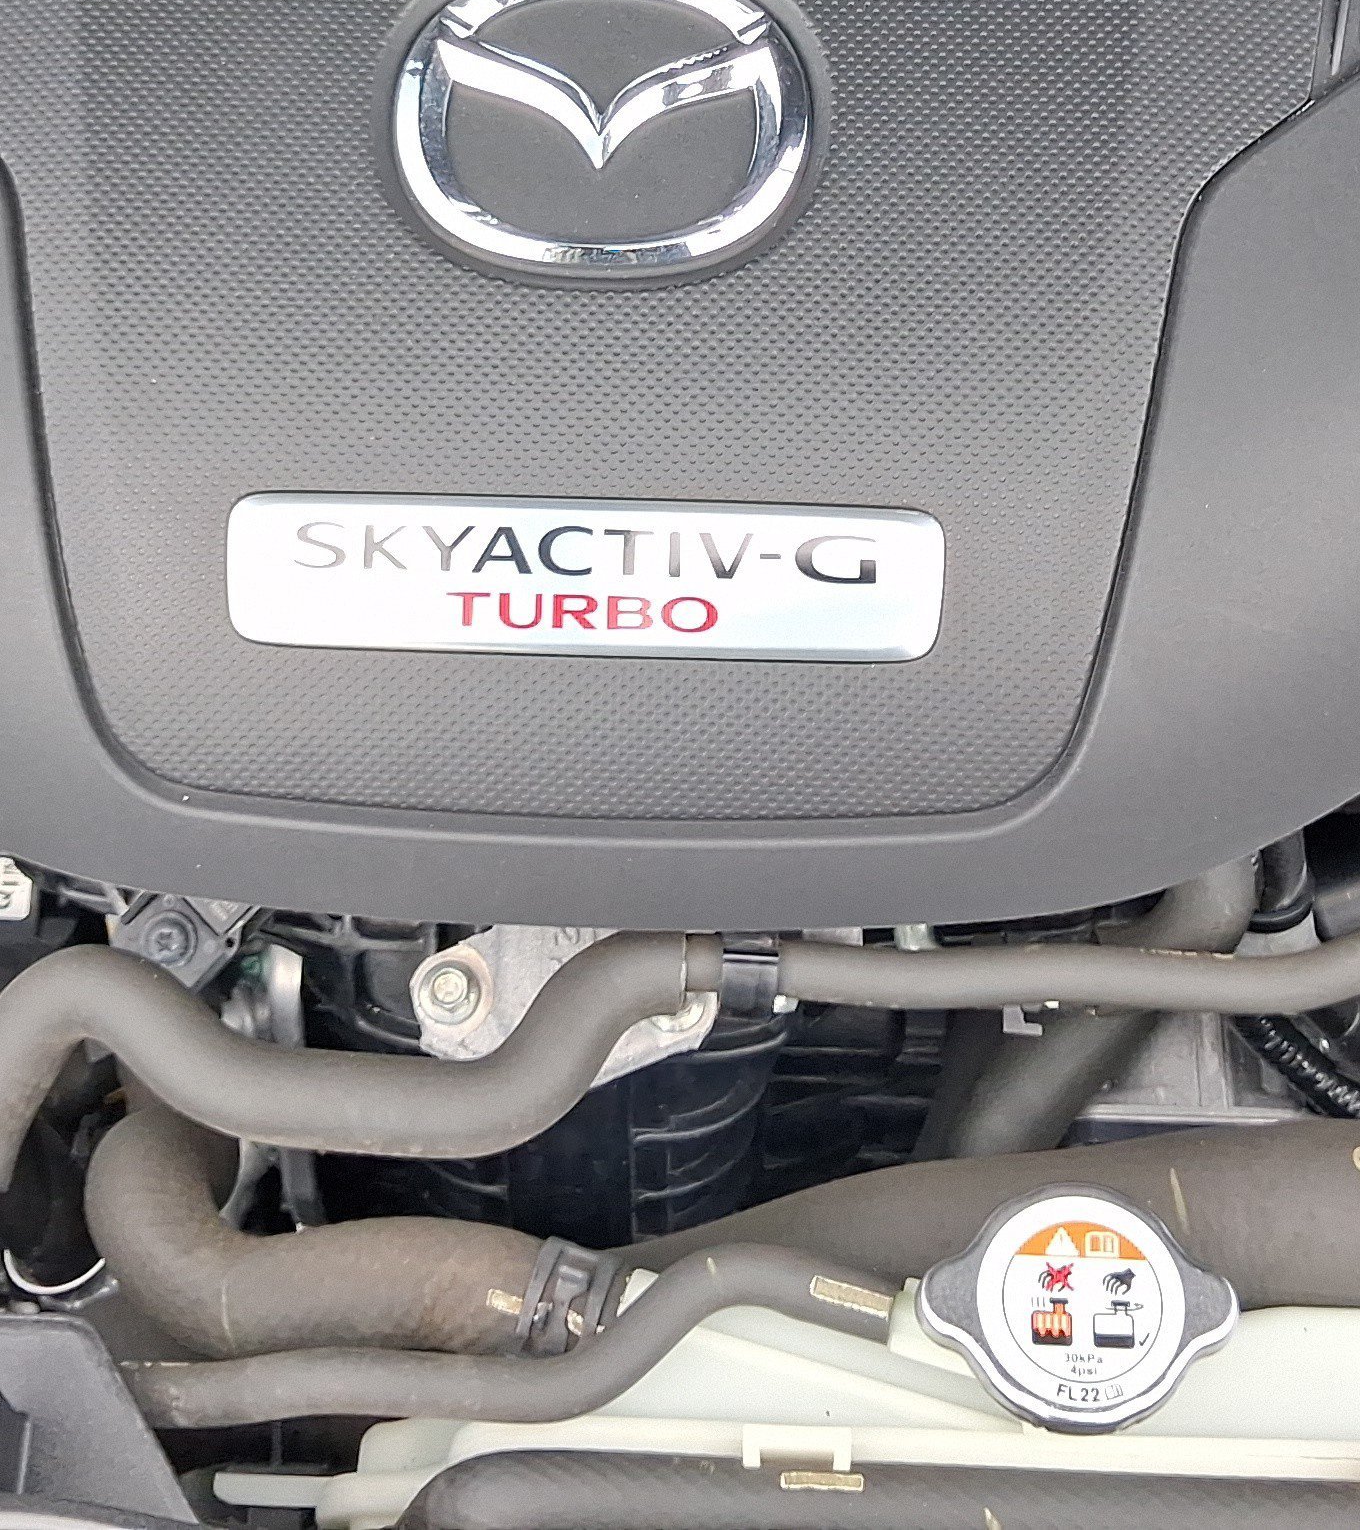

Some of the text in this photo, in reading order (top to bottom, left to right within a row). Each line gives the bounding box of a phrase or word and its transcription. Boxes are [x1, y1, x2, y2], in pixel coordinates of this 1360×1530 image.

[293, 521, 877, 584] SKYACTIV-G
[445, 591, 719, 633] TURBO
[1056, 1383, 1100, 1402] FL22
